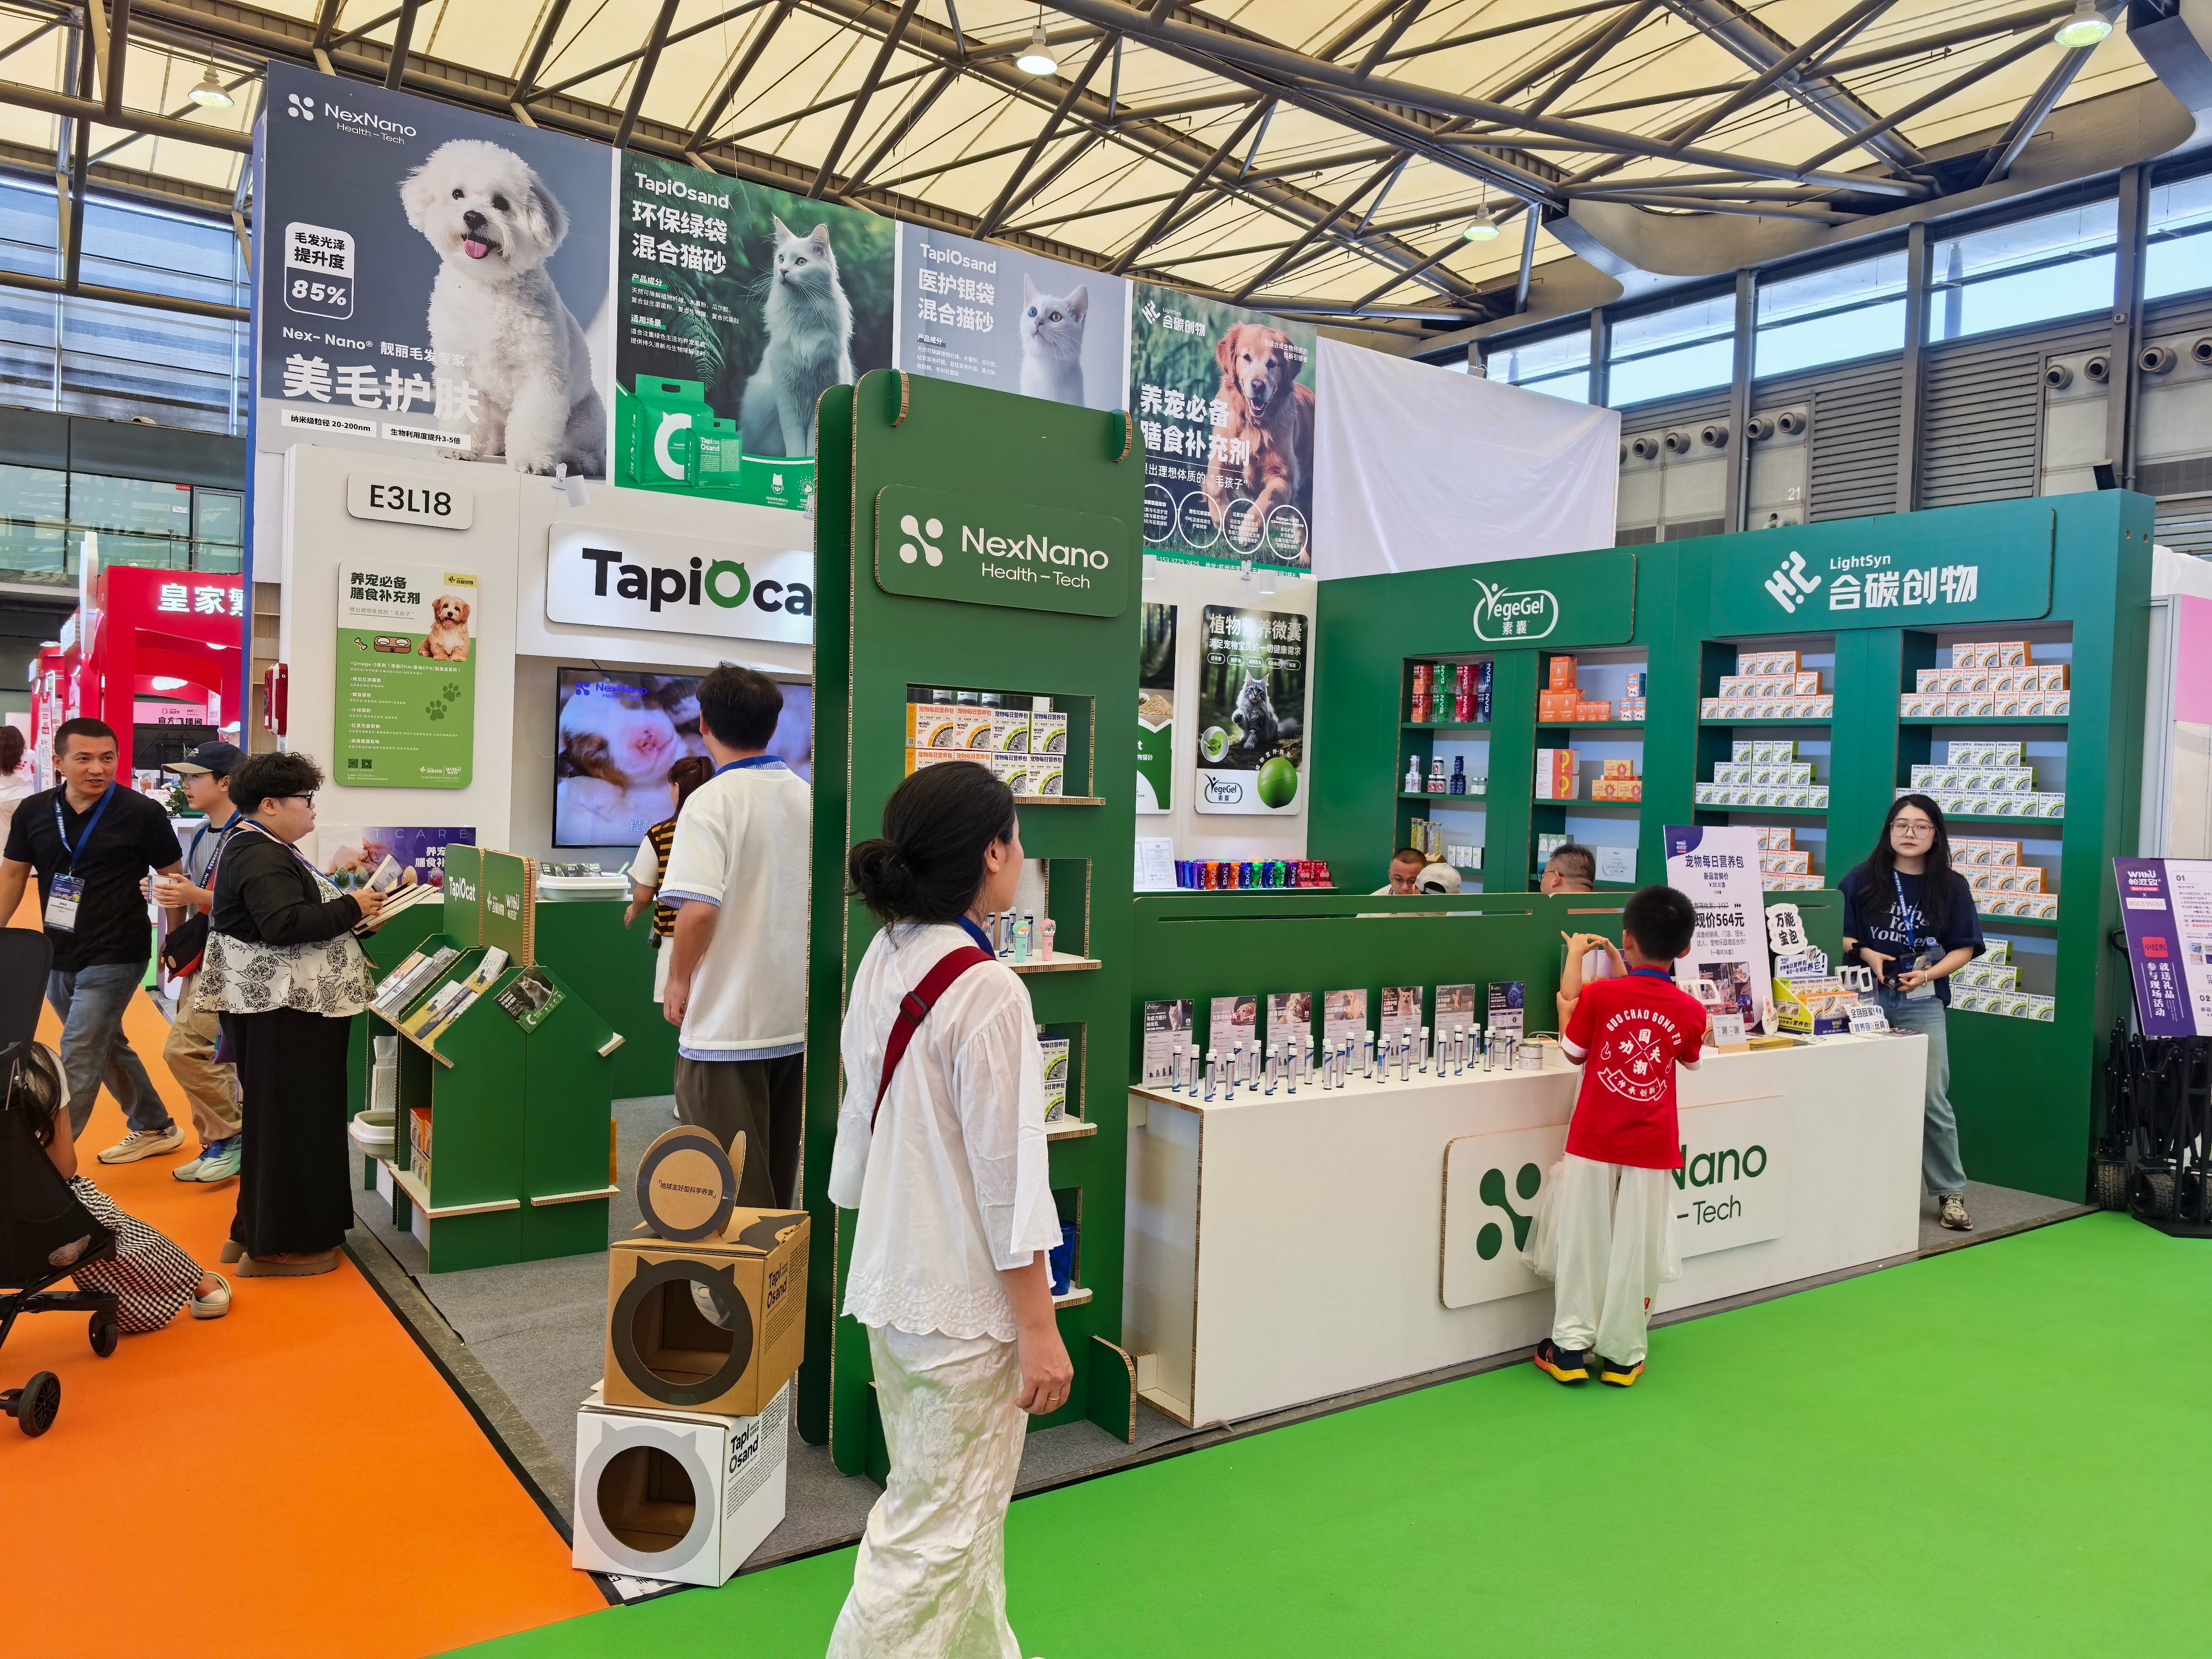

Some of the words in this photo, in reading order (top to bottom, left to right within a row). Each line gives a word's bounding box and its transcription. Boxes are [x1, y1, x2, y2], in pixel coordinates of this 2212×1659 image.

[325, 103, 416, 137] NexNano
[337, 122, 371, 137] Health
[381, 132, 405, 145] Tech
[634, 172, 729, 209] TapiOsand
[632, 200, 727, 245] 环保绿袋
[294, 232, 345, 251] 毛发光泽
[631, 233, 727, 274] 混合猫砂
[294, 247, 345, 269] 提升度
[920, 243, 996, 274] TapiOsand
[632, 273, 663, 287] 产品成分
[919, 268, 995, 306] 医护银袋
[292, 279, 347, 306] 85%
[631, 314, 662, 327] 适用场景
[918, 297, 994, 333] 混合猫砂
[1163, 307, 1182, 316] LightSyn
[1163, 315, 1205, 337] 合碳创物
[918, 334, 942, 345] 产品成分
[380, 341, 465, 368] 靓丽毛发专家
[1283, 352, 1308, 363] 创新引领者
[282, 353, 480, 424] 美毛护肤
[1140, 383, 1230, 428] 养宠必备
[291, 415, 330, 427] 纳米级粒径
[332, 421, 370, 432] 20-200nm
[390, 428, 461, 445] 生物利用度提升3-5倍
[1140, 420, 1250, 467] 膳食补充剂
[370, 484, 451, 516] E3L18
[1788, 487, 1800, 501] 21
[962, 525, 1109, 570] NexNano
[1830, 555, 1890, 571] LightSyn
[351, 572, 407, 589] 养宠必备
[582, 548, 813, 616] TapiOca
[982, 562, 1036, 583] Health
[1053, 571, 1090, 589] Tech
[1829, 565, 1978, 610] 合碳创物
[350, 586, 420, 604] 膳食补充剂
[1209, 613, 1302, 642] 植物营养微囊
[1209, 638, 1301, 656] 满足宠物宝贝的一切健康需求
[957, 708, 992, 716] 宠物每日营养包
[1685, 855, 1744, 868] 宠物每日营养包
[2127, 870, 2156, 878] WithU
[449, 876, 476, 902] TapiOcat
[506, 894, 520, 911] WithU
[1696, 912, 1744, 928] 现价564元
[1775, 912, 1796, 928] 万能
[2147, 962, 2165, 1017] 参与现场活动
[2159, 962, 2175, 999] 就送礼品
[1606, 1013, 1624, 1032] GUO
[1623, 1008, 1649, 1020] CHAO
[1651, 1011, 1675, 1032] GONG
[1618, 1040, 1634, 1055] 功
[1638, 1029, 1651, 1044] 国
[1649, 1046, 1662, 1063] 夫
[1633, 1060, 1648, 1076] 潮
[1693, 1195, 1741, 1225] Tech
[769, 1263, 781, 1289] Tapi
[767, 1276, 787, 1309] Osand
[731, 1423, 750, 1453] Tapi
[729, 1434, 759, 1474] Osand
